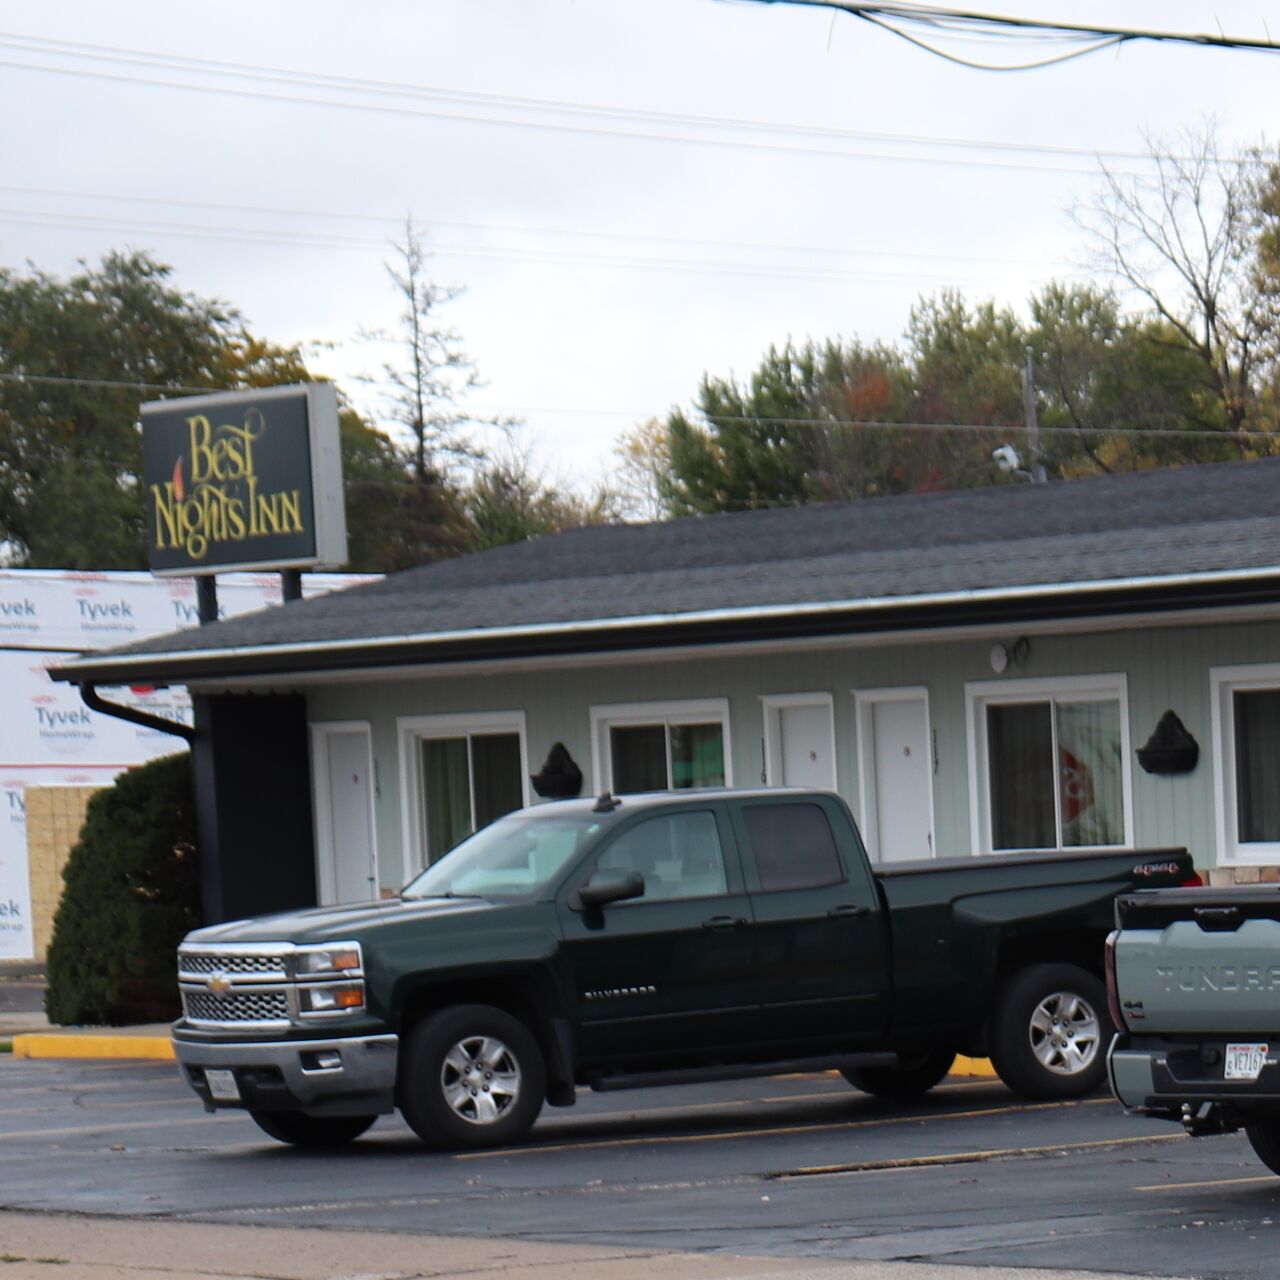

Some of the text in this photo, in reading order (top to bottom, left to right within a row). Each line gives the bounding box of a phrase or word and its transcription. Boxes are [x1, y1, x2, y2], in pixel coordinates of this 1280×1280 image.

[186, 407, 266, 483] Best
[151, 480, 246, 559] Nights
[76, 599, 132, 619] Tyvek
[35, 706, 92, 728] Tyvek
